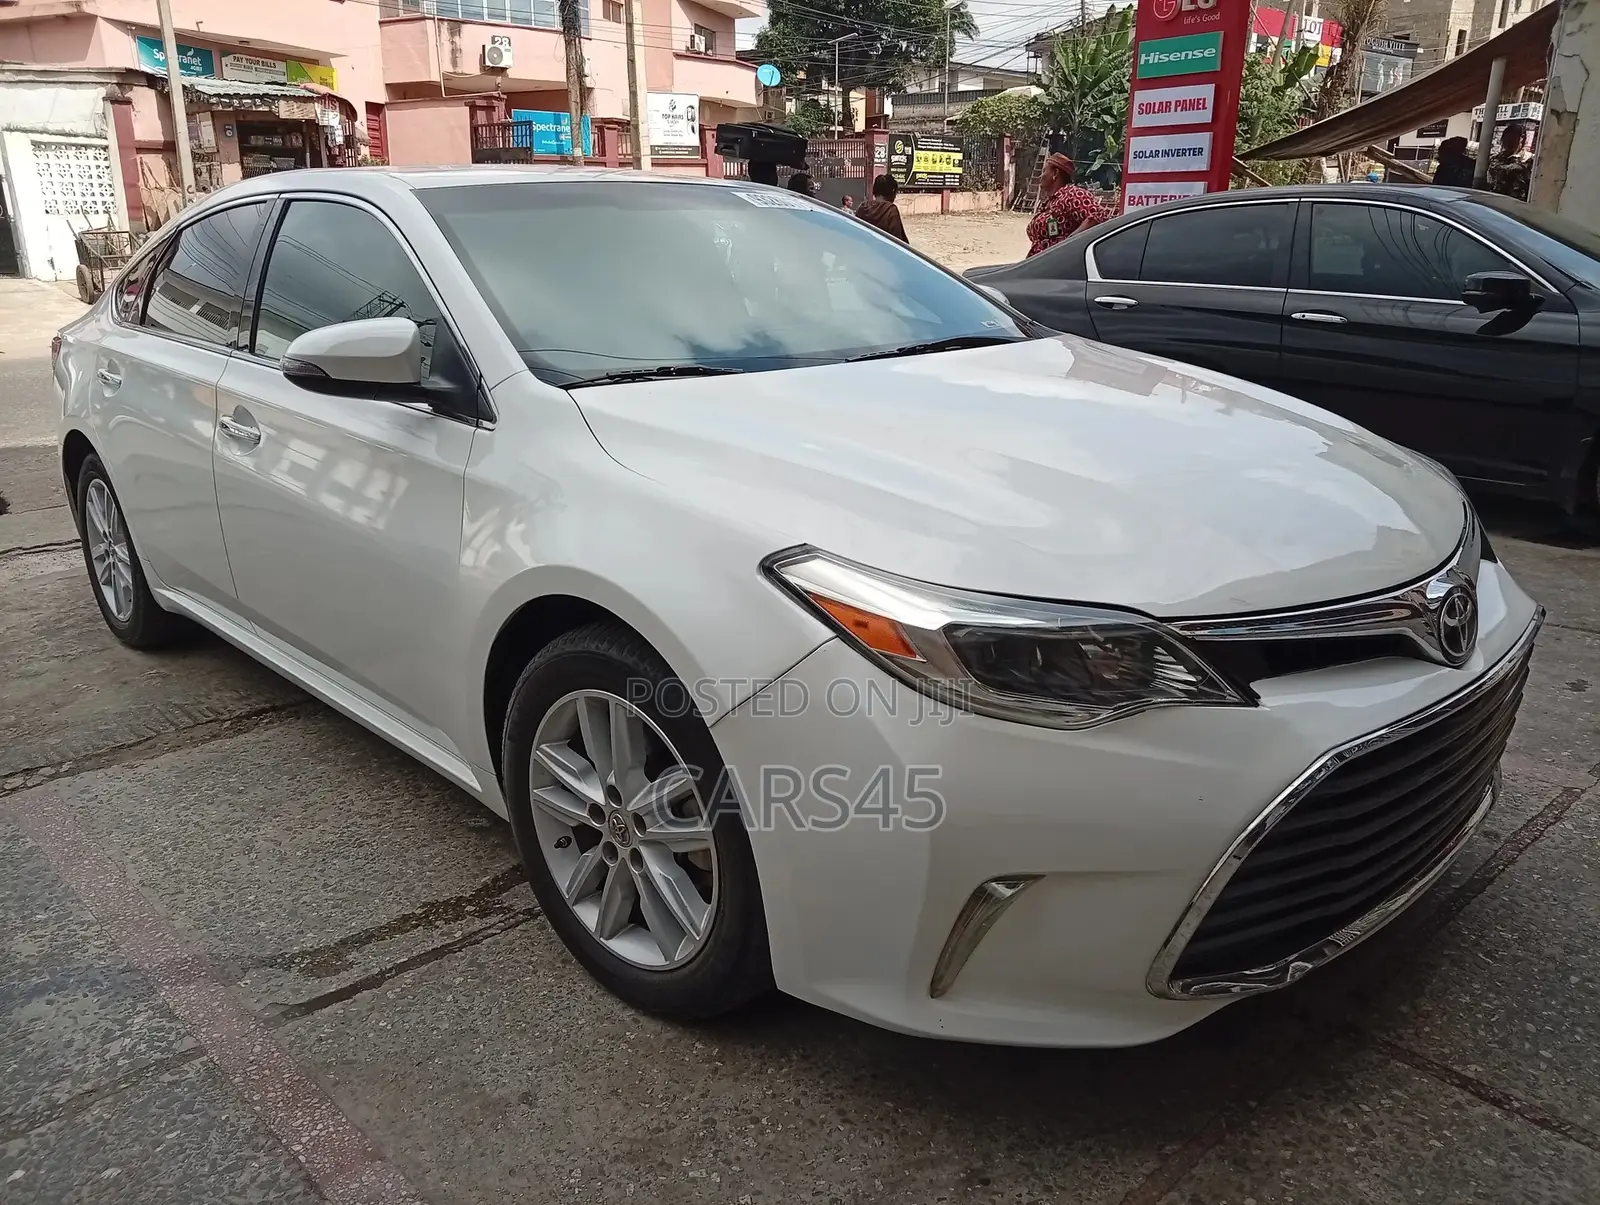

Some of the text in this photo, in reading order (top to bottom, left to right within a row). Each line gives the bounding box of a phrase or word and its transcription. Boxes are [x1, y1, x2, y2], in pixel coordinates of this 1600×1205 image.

[1183, 12, 1220, 25] Life's Good
[153, 48, 202, 66] Spranet
[232, 55, 277, 69] PAY YOUR BILLS
[1140, 47, 1216, 65] Hisense
[1137, 97, 1208, 116] SOLAR PANEL
[532, 121, 571, 133] Spectrane
[1133, 147, 1204, 160] SOLAR INVERTER
[1127, 194, 1194, 206] BATTER
